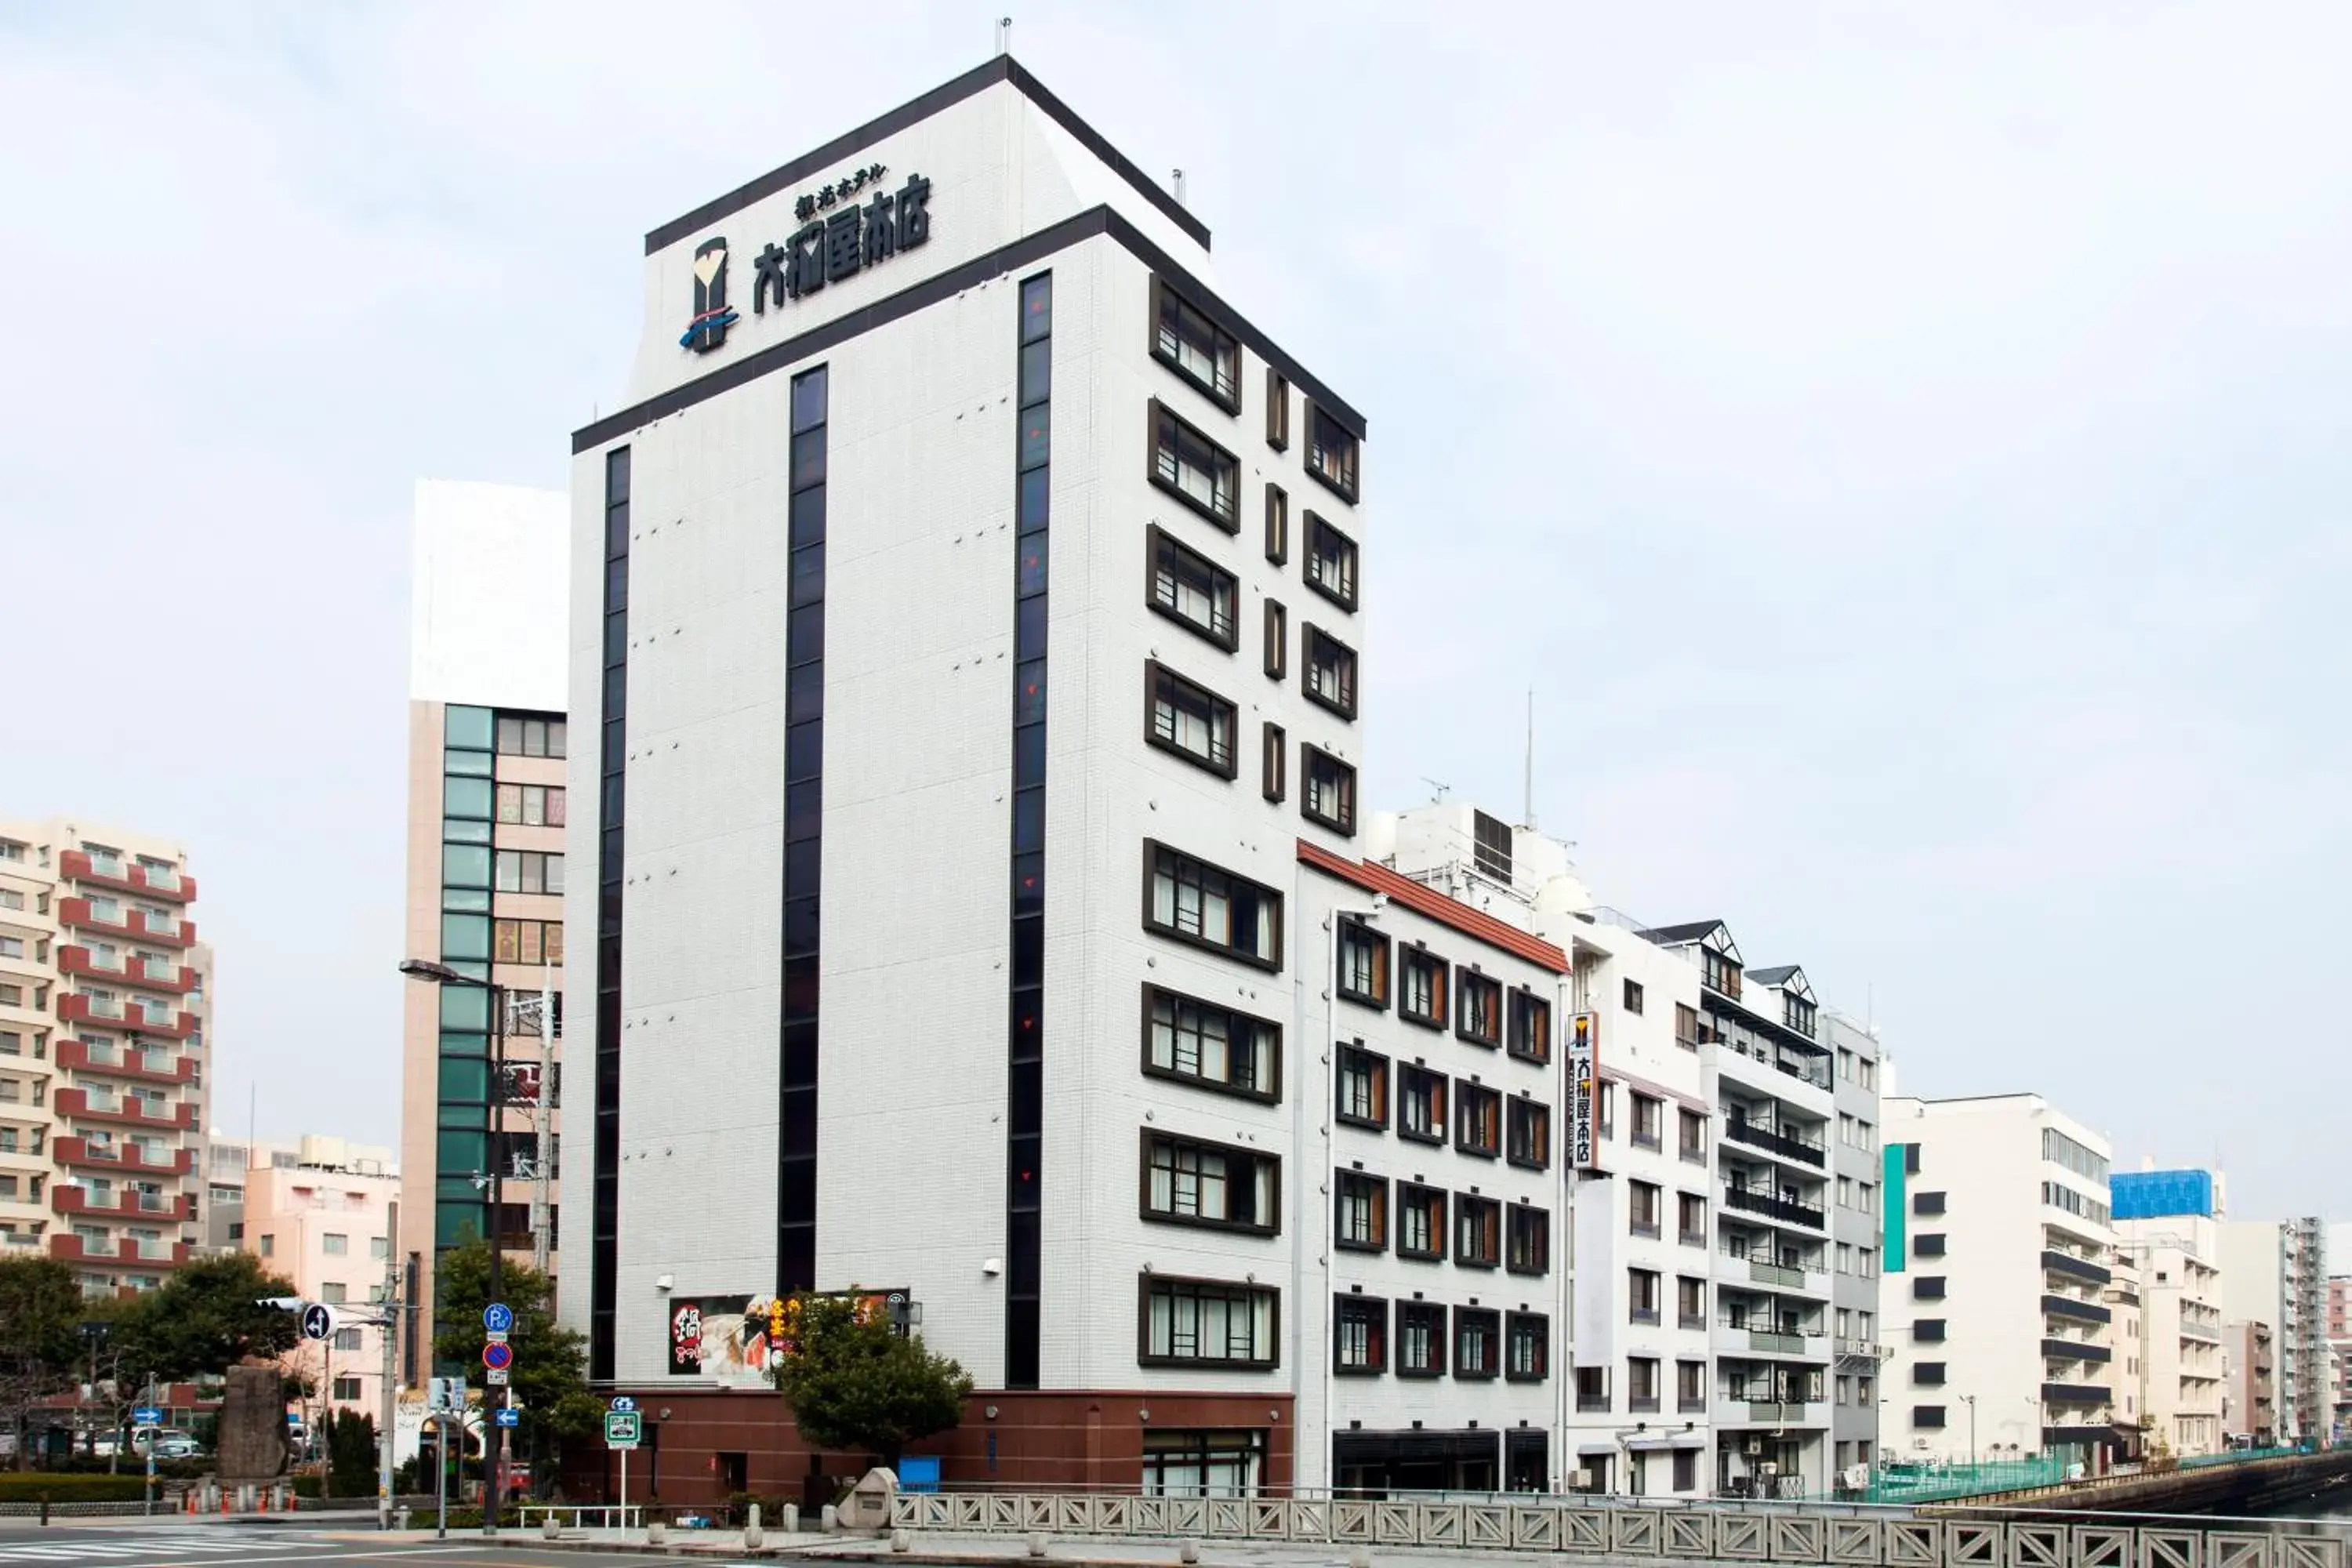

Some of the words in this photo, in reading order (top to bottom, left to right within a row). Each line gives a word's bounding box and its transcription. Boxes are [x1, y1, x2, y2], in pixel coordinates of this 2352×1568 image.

[753, 172, 931, 315] 大和屋本店
[1577, 1057, 1592, 1163] 大和屋本店
[490, 1309, 501, 1327] P
